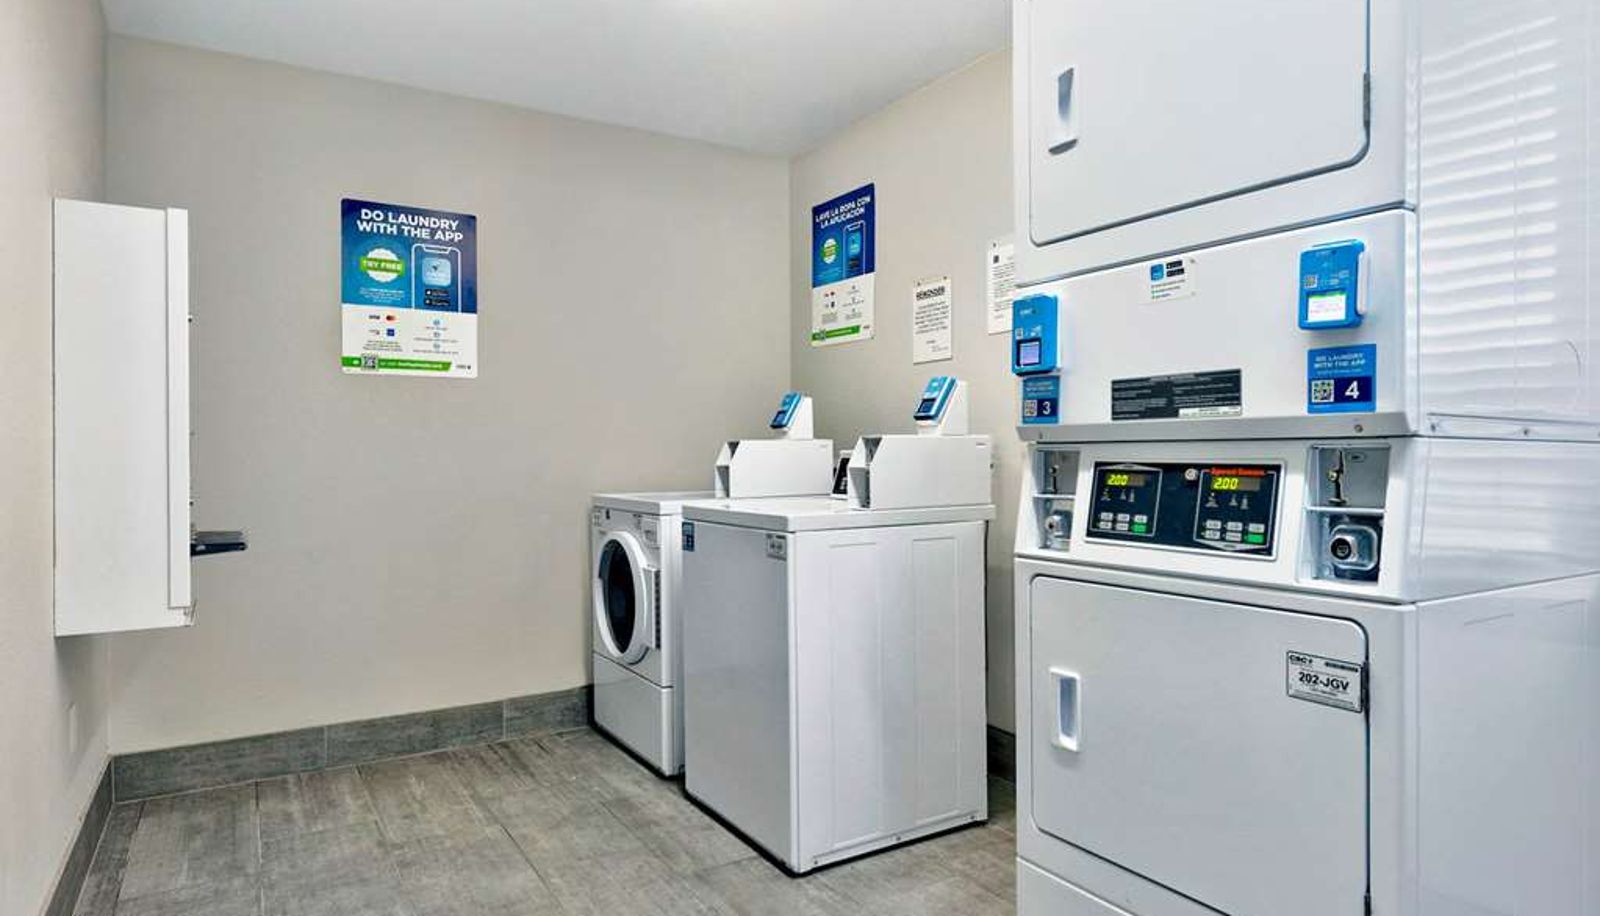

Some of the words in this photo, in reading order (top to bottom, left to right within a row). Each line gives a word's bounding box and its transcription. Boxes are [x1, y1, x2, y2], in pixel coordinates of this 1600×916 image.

[361, 208, 384, 221] DO
[388, 212, 459, 231] LAUNDRY
[815, 210, 830, 223] LAVE
[840, 201, 856, 212] ROPA
[857, 196, 871, 207] CON
[357, 220, 397, 235] WITH
[401, 225, 431, 240] THE
[434, 230, 464, 243] APP
[820, 220, 829, 229] LA
[362, 259, 379, 269] TRY
[381, 261, 403, 271] FREE
[1344, 380, 1360, 400] 4
[1042, 401, 1051, 415] 3
[1298, 671, 1350, 691] 202-JGV
